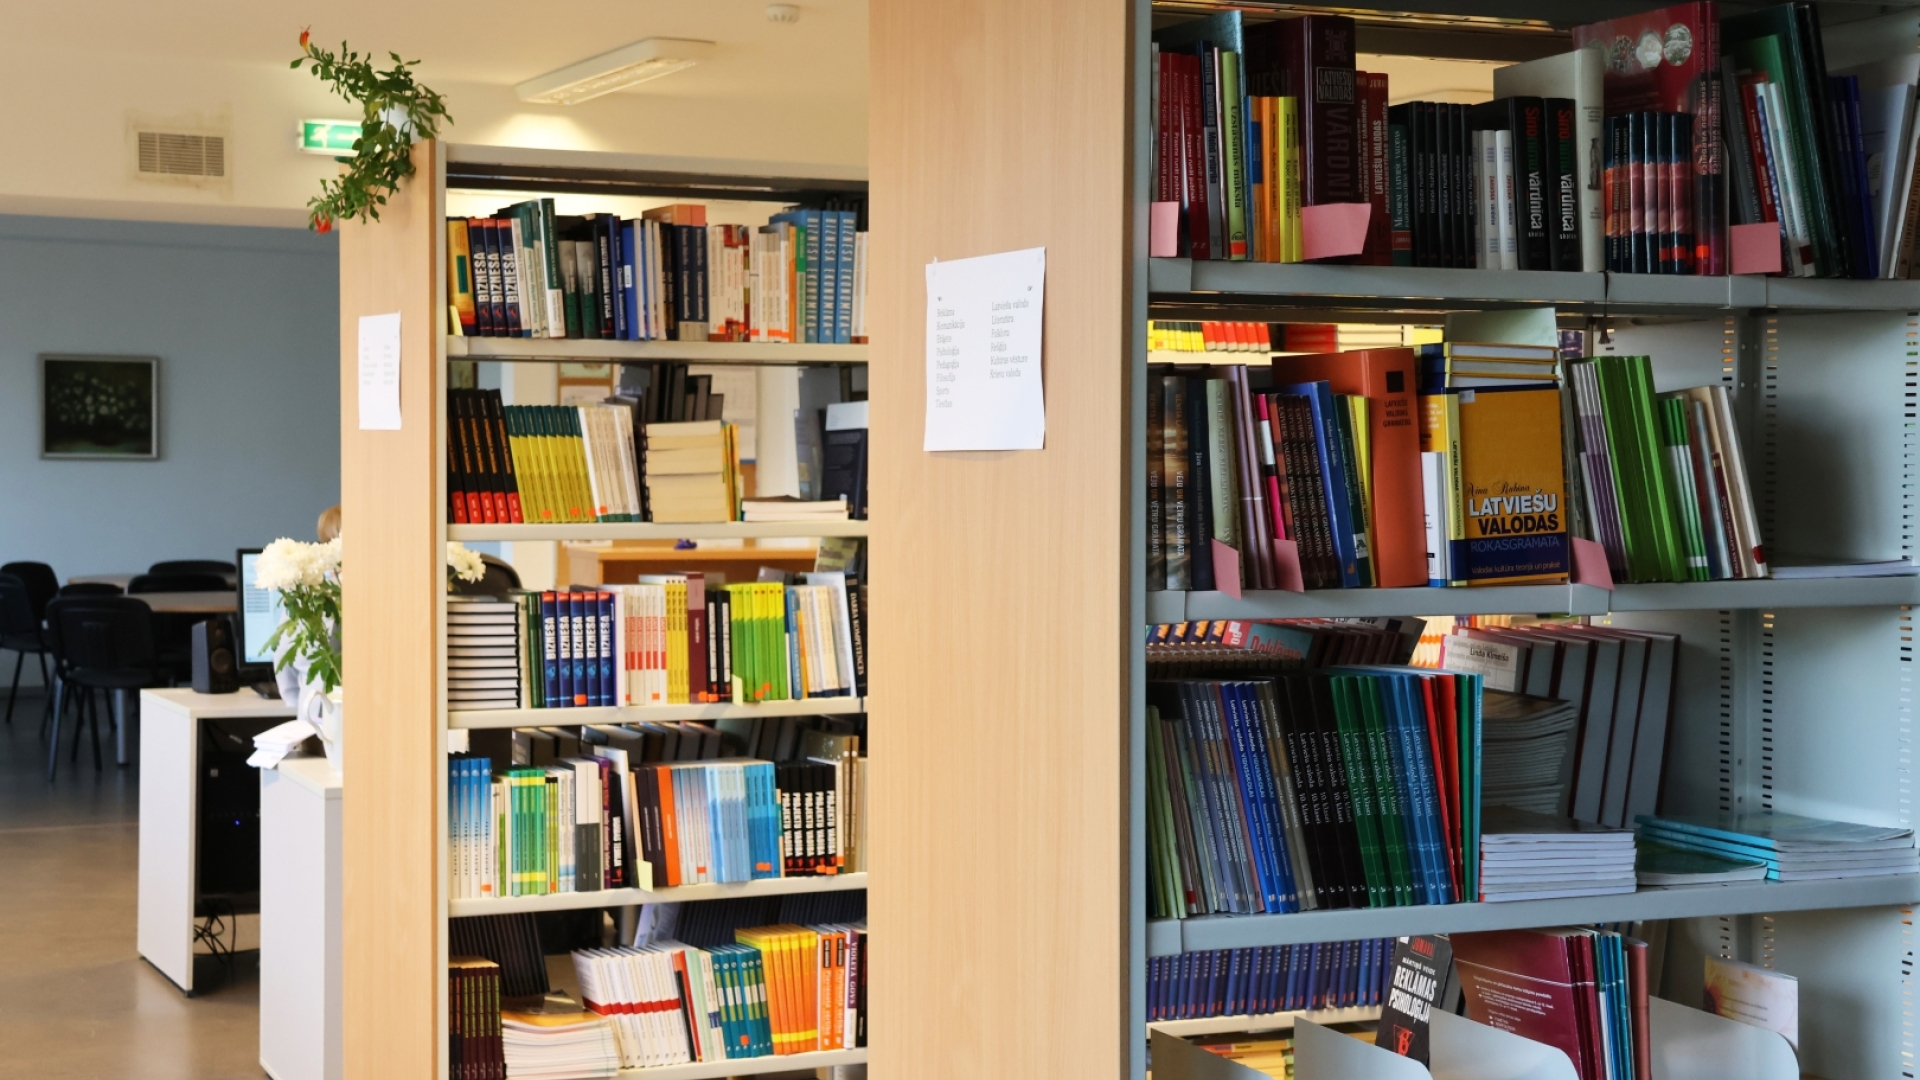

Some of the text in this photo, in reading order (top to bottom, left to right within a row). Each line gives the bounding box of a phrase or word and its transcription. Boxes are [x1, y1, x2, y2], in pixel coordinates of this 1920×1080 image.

[1161, 132, 1169, 156] Prasme
[1186, 134, 1194, 158] Prasme
[1195, 134, 1203, 158] Prasme
[1231, 106, 1242, 208] Uzstāšanās māksla
[1161, 157, 1169, 175] runāt
[1187, 159, 1195, 176] runāt
[1196, 159, 1204, 176] runāt
[1161, 176, 1169, 201] publiski
[1188, 176, 1197, 202] publiski
[1197, 178, 1205, 203] publiski
[1528, 171, 1544, 229] vārdnīca
[474, 252, 490, 303] BIZNESA
[488, 252, 504, 303] BIZNESA
[503, 253, 518, 304] BIZNESA
[806, 218, 818, 328] BIZNESA EKONOMIKA
[824, 218, 835, 328] BIZNESA EKONOMIKA
[839, 219, 853, 328] BIZNESA EKONOMIKA
[1176, 471, 1185, 487] VĒJU
[1284, 442, 1294, 474] VALODAS
[1289, 476, 1300, 516] PRAKTISKĀ
[1177, 500, 1186, 523] VĒTRU
[1469, 489, 1557, 517] LATVIEŠU
[1478, 514, 1559, 535] VALODAS
[1177, 524, 1186, 557] GRĀMATA
[544, 617, 556, 660] BIZNESA
[560, 616, 570, 659] BIZNESA
[573, 616, 584, 659] BIZNESA
[586, 616, 596, 658] BIZNESA
[600, 616, 611, 658] BIZNESA
[850, 592, 864, 675] DARBA KOMPETENCES
[1230, 700, 1241, 727] Latviešu
[1241, 700, 1253, 727] Latviešu
[1235, 728, 1246, 752] valoda
[1246, 728, 1257, 752] valoda
[1342, 732, 1354, 763] Latviešu
[1352, 732, 1364, 762] Latviešu
[1367, 731, 1380, 762] Latviešu
[1378, 731, 1390, 762] Latviešu
[1404, 730, 1416, 760] Latviešu
[1414, 730, 1426, 760] Latviešu
[1287, 733, 1310, 826] Latviešu valoda 10. klasei
[1299, 732, 1322, 825] Latviešu valoda 10. klasei
[1321, 731, 1345, 824] Latviešu valoda 10. klasei
[1347, 763, 1357, 784] valoda
[1357, 763, 1367, 783] valoda
[1372, 762, 1383, 783] valoda
[1383, 762, 1394, 783] valoda
[1408, 760, 1419, 783] valoda
[1418, 760, 1429, 783] valoda
[782, 792, 791, 829] PROJEKTU
[793, 792, 802, 829] PROJEKTU
[805, 792, 814, 828] PROJEKTU
[815, 792, 825, 828] PROJEKTU
[827, 790, 835, 826] PROJEKTU
[1352, 797, 1363, 817] klasei
[1362, 797, 1372, 817] klasei
[1378, 797, 1388, 817] klasei
[1388, 796, 1398, 816] klasei
[1414, 797, 1424, 817] klasei
[1424, 797, 1434, 817] klasei
[1394, 965, 1437, 1002] REKLĀMAS
